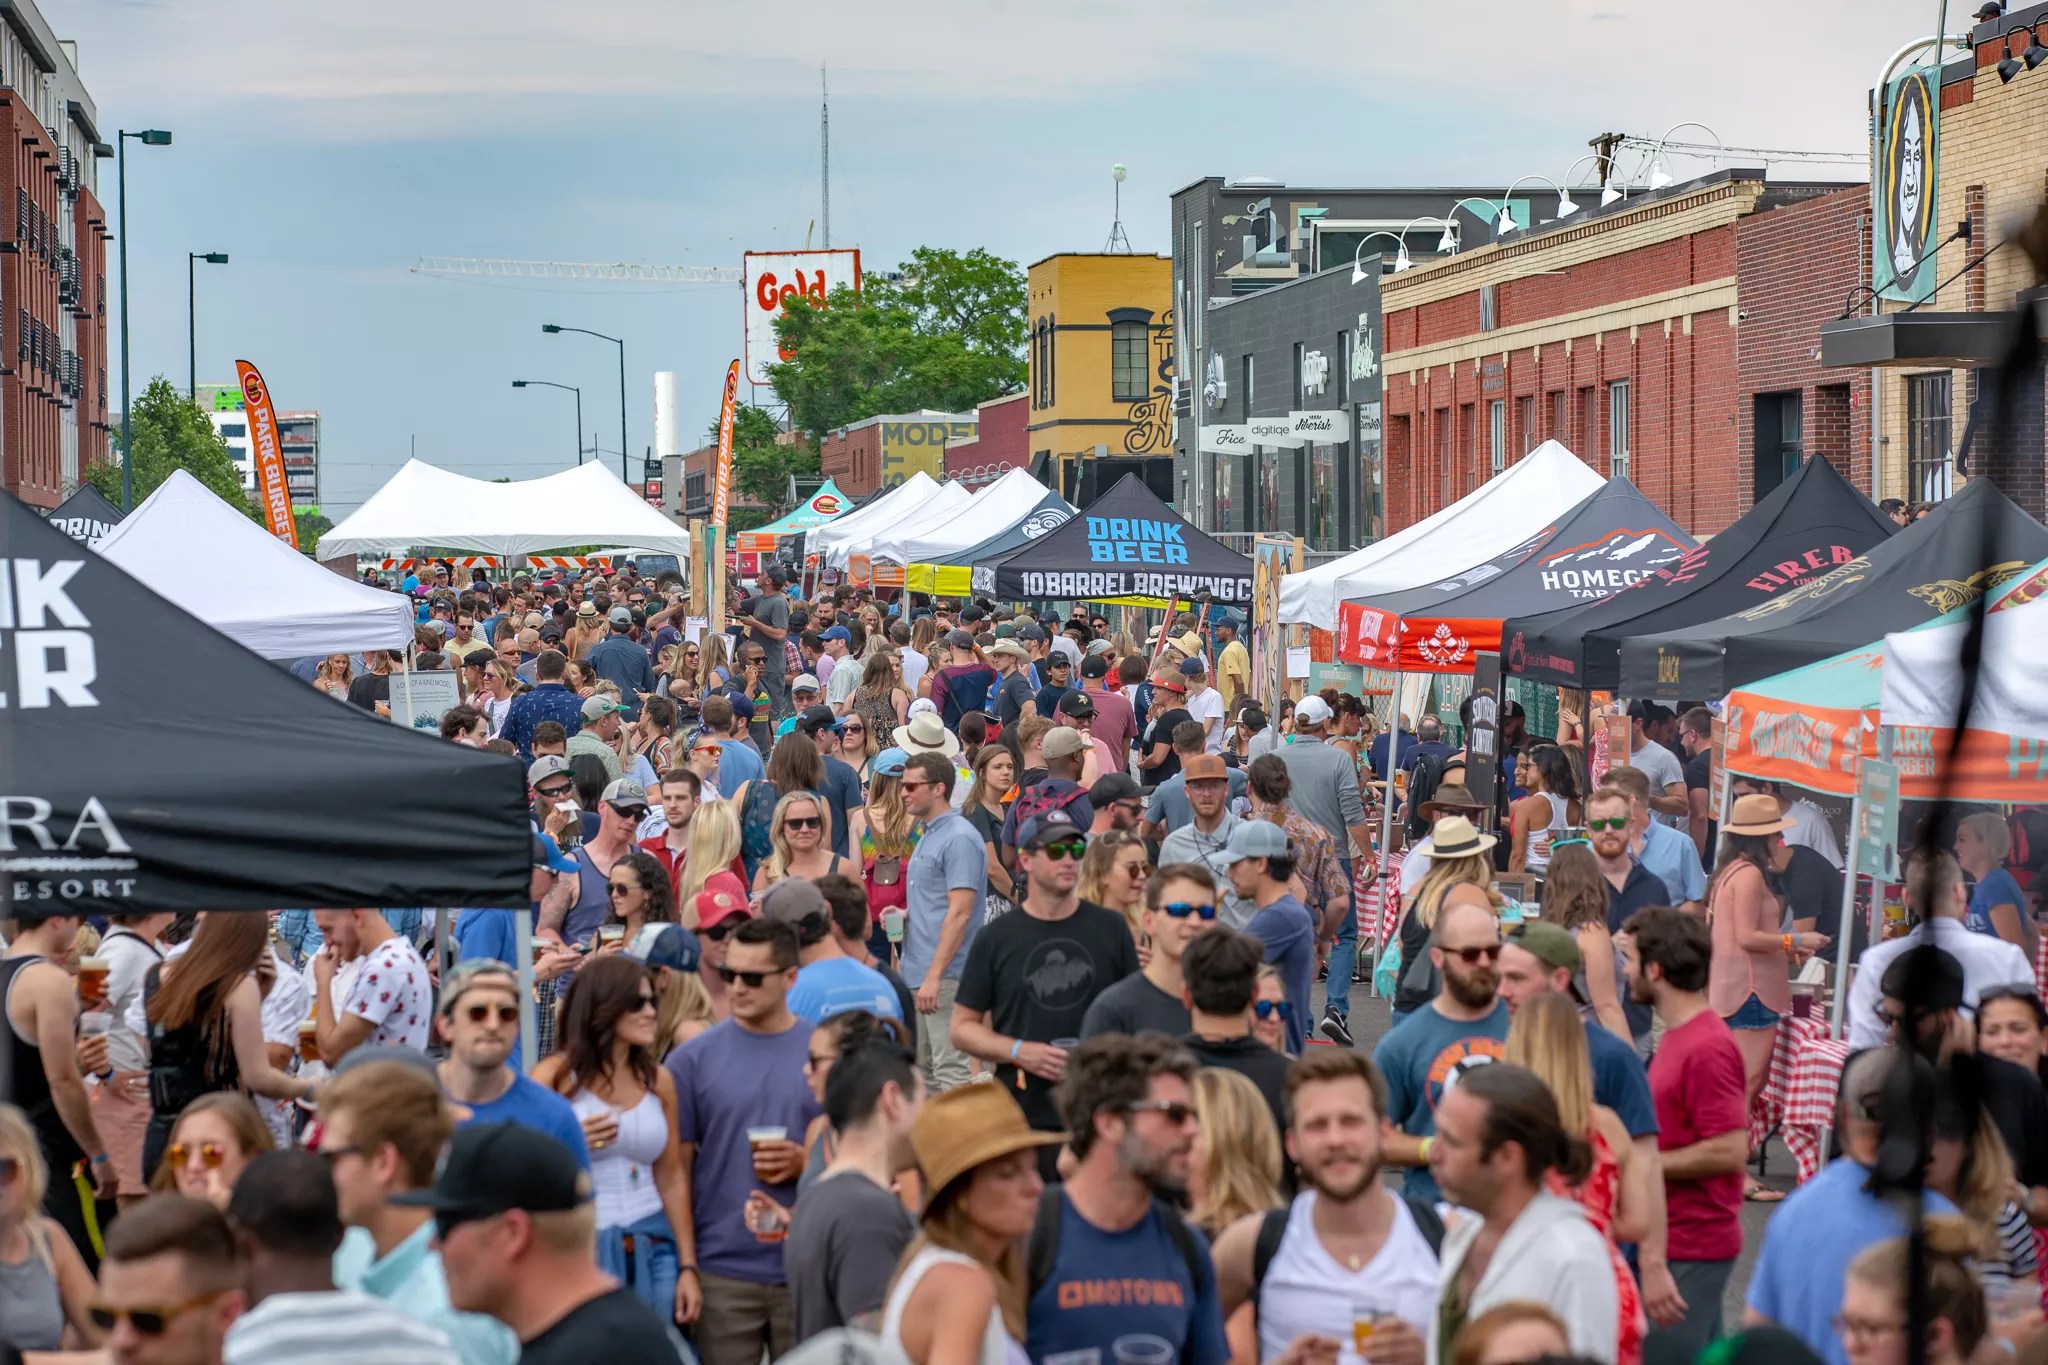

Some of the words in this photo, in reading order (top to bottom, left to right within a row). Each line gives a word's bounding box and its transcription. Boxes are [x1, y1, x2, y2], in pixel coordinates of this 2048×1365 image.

[757, 269, 829, 311] Gold
[254, 407, 277, 464] PARK
[719, 405, 731, 460] PARK
[882, 423, 980, 446] MODE
[1252, 425, 1290, 436] digitiqe
[49, 517, 118, 538] DRIN
[1086, 516, 1186, 544] DRINK
[1089, 541, 1190, 565] BEER
[1237, 578, 1254, 601] C
[1568, 589, 1609, 598] TAP
[0, 878, 137, 901] ESORT
